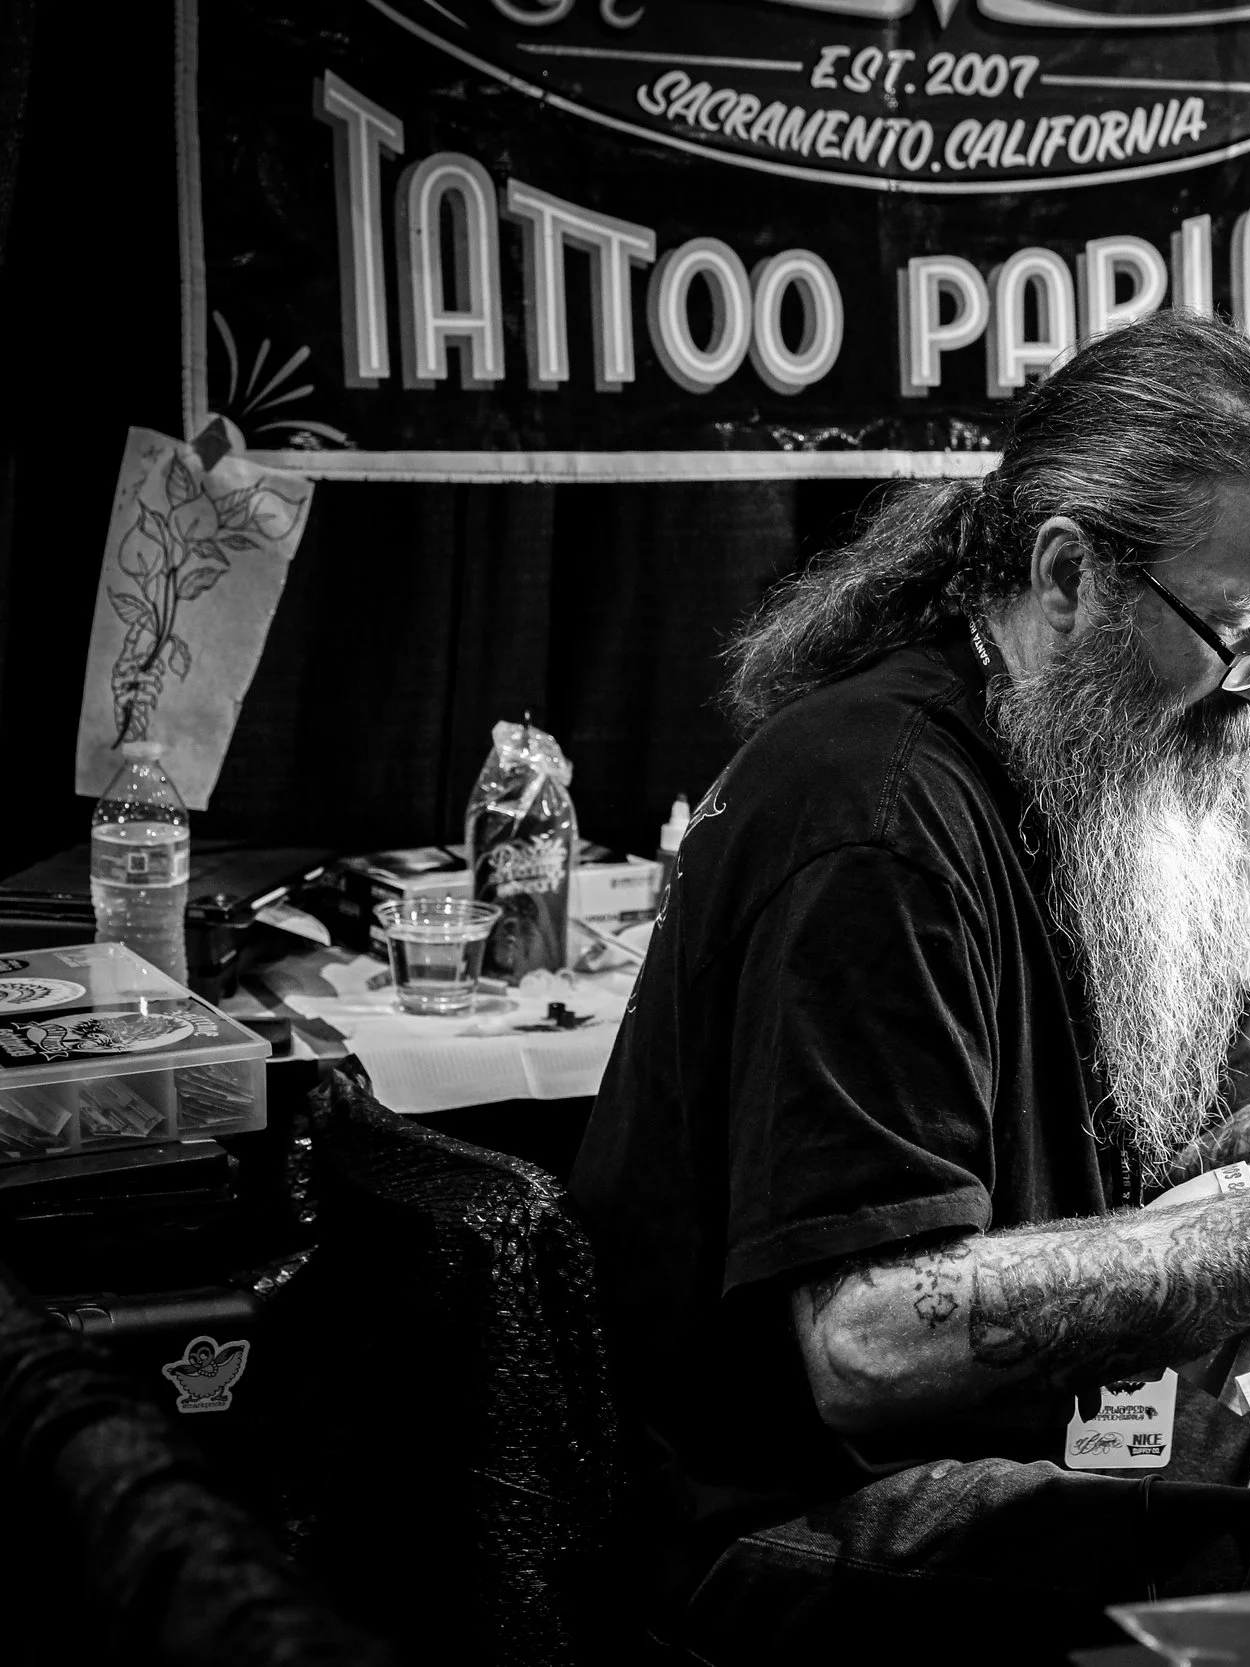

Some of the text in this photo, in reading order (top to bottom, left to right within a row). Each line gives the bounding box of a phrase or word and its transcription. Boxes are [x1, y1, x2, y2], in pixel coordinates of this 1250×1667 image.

[811, 45, 1040, 98] EST. 2007
[314, 69, 844, 393] TATTOO
[973, 633, 990, 666] SANTA
[1132, 1433, 1162, 1446] NICE
